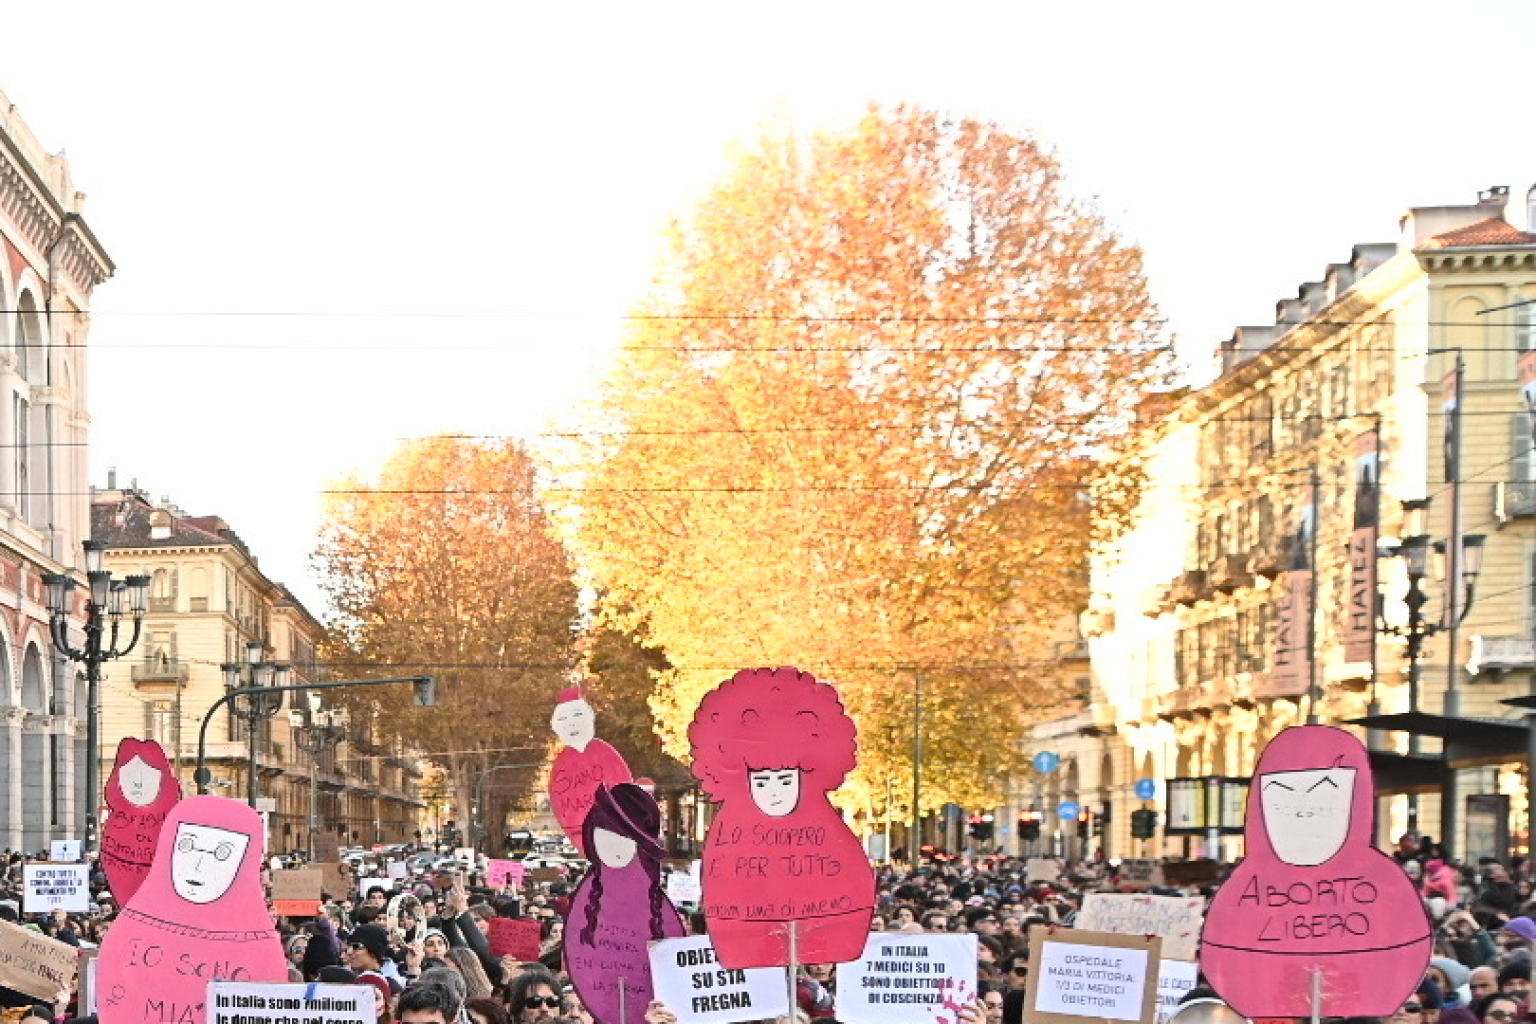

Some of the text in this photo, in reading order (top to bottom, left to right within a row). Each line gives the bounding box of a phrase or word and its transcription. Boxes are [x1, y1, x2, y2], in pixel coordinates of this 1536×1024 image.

[714, 820, 826, 847] LO SCIOPERO
[734, 855, 769, 878] PER
[1237, 873, 1378, 907] ABORTO
[1257, 911, 1370, 941] LIBERO
[128, 937, 164, 968] IO
[881, 945, 928, 957] IN ITALIA
[865, 960, 945, 974] 7 MEDICI SU 10
[1063, 954, 1123, 969] OSPEDALE
[691, 968, 746, 989] SU STA
[1047, 966, 1083, 978] MARIA
[861, 976, 891, 989] SONO
[1072, 981, 1085, 991] DI
[1086, 982, 1125, 995] MEDICI
[215, 993, 229, 1008] In
[232, 994, 266, 1008] Italia
[268, 998, 301, 1010] sono
[691, 991, 752, 1014] FREGNA
[867, 993, 943, 1004] DI COSCIENZA
[1061, 993, 1116, 1008] OBIETTORI
